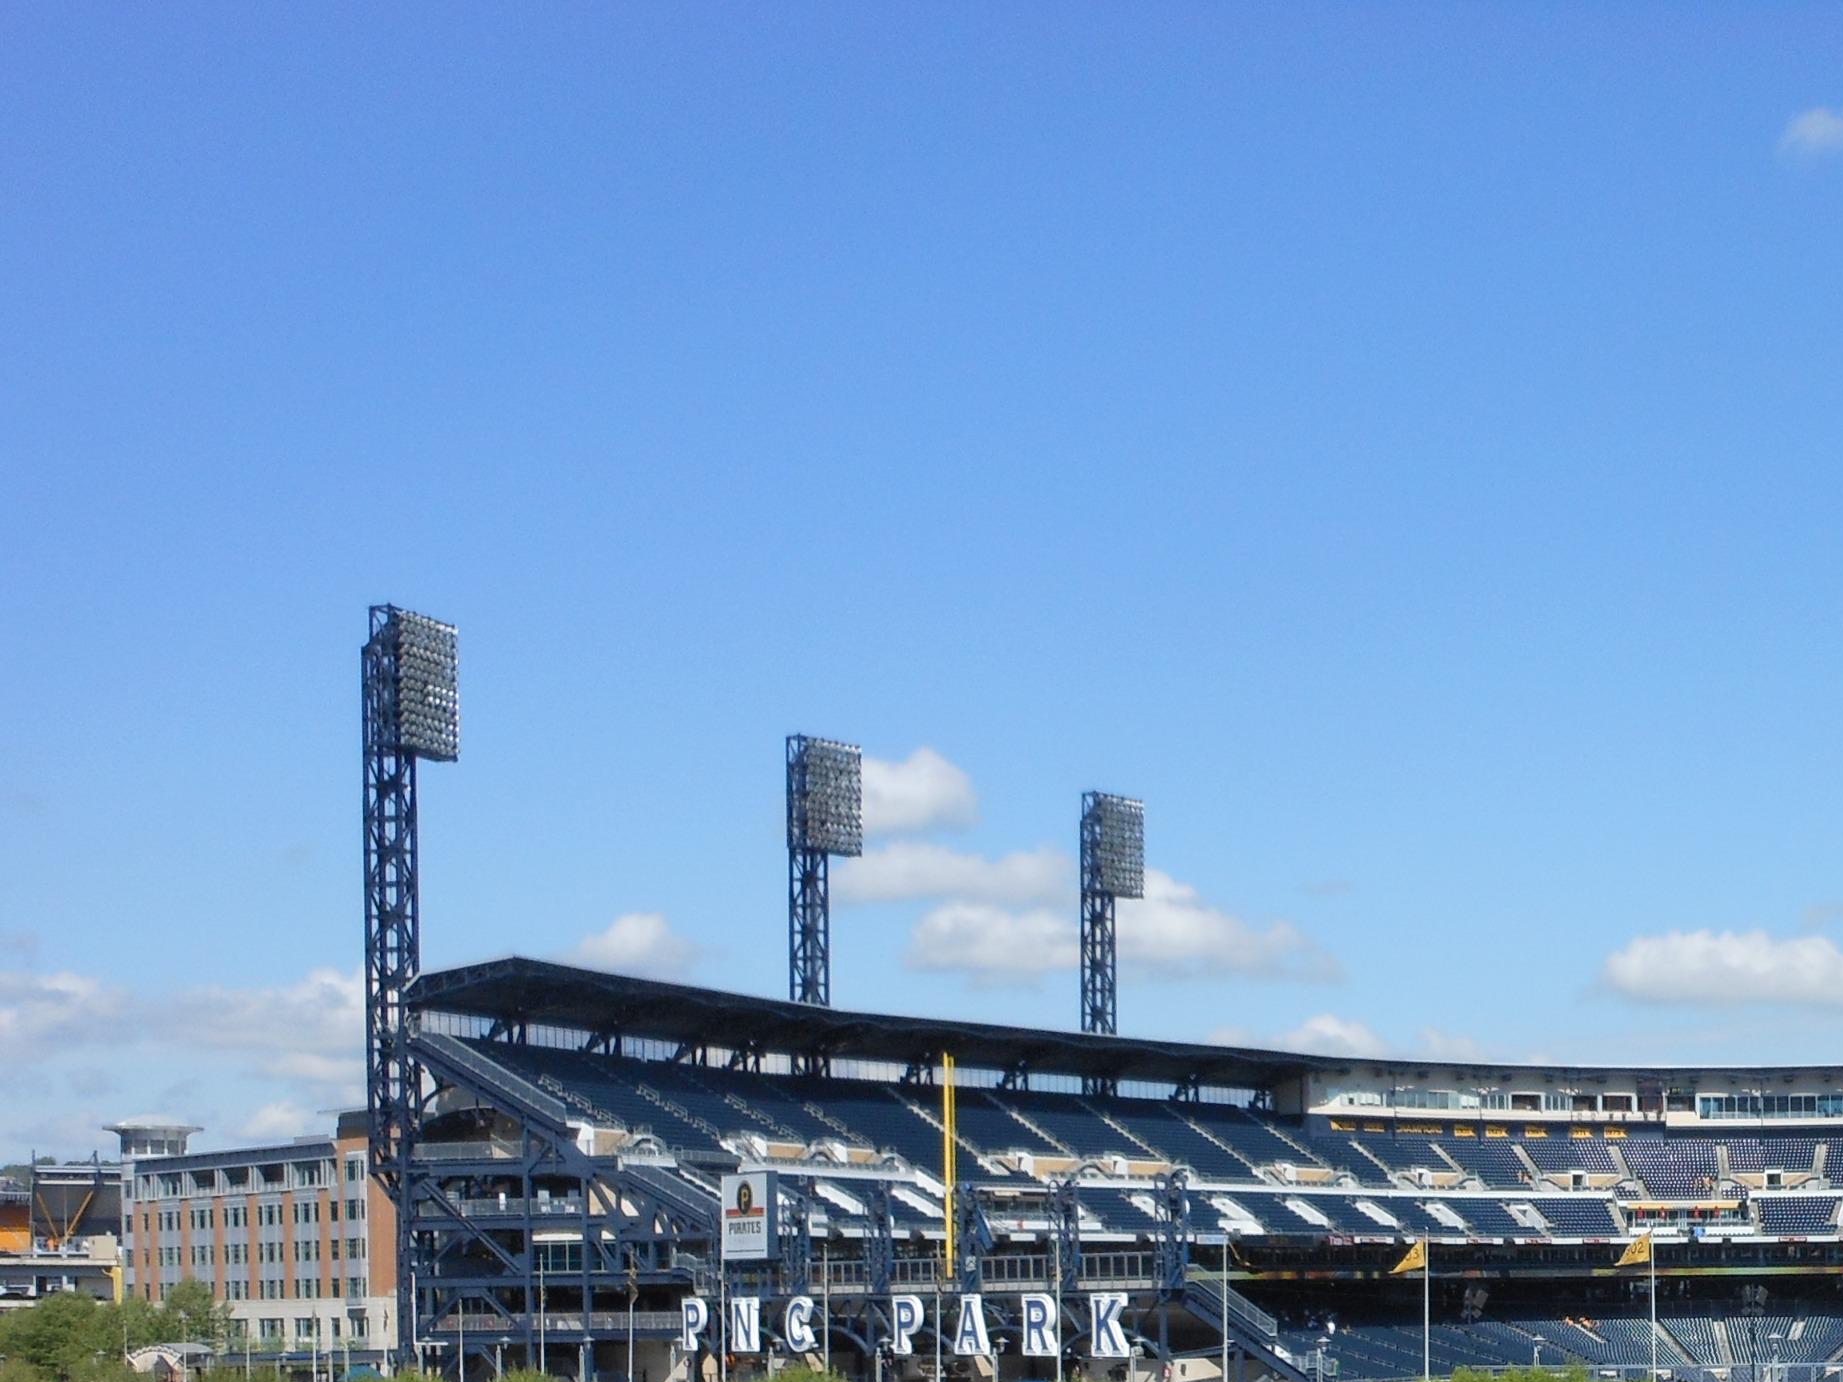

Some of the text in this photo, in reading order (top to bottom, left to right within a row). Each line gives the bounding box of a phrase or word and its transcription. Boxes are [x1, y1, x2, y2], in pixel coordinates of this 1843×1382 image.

[729, 1221, 761, 1235] PIRATES
[681, 1293, 1131, 1357] PNC PARK
